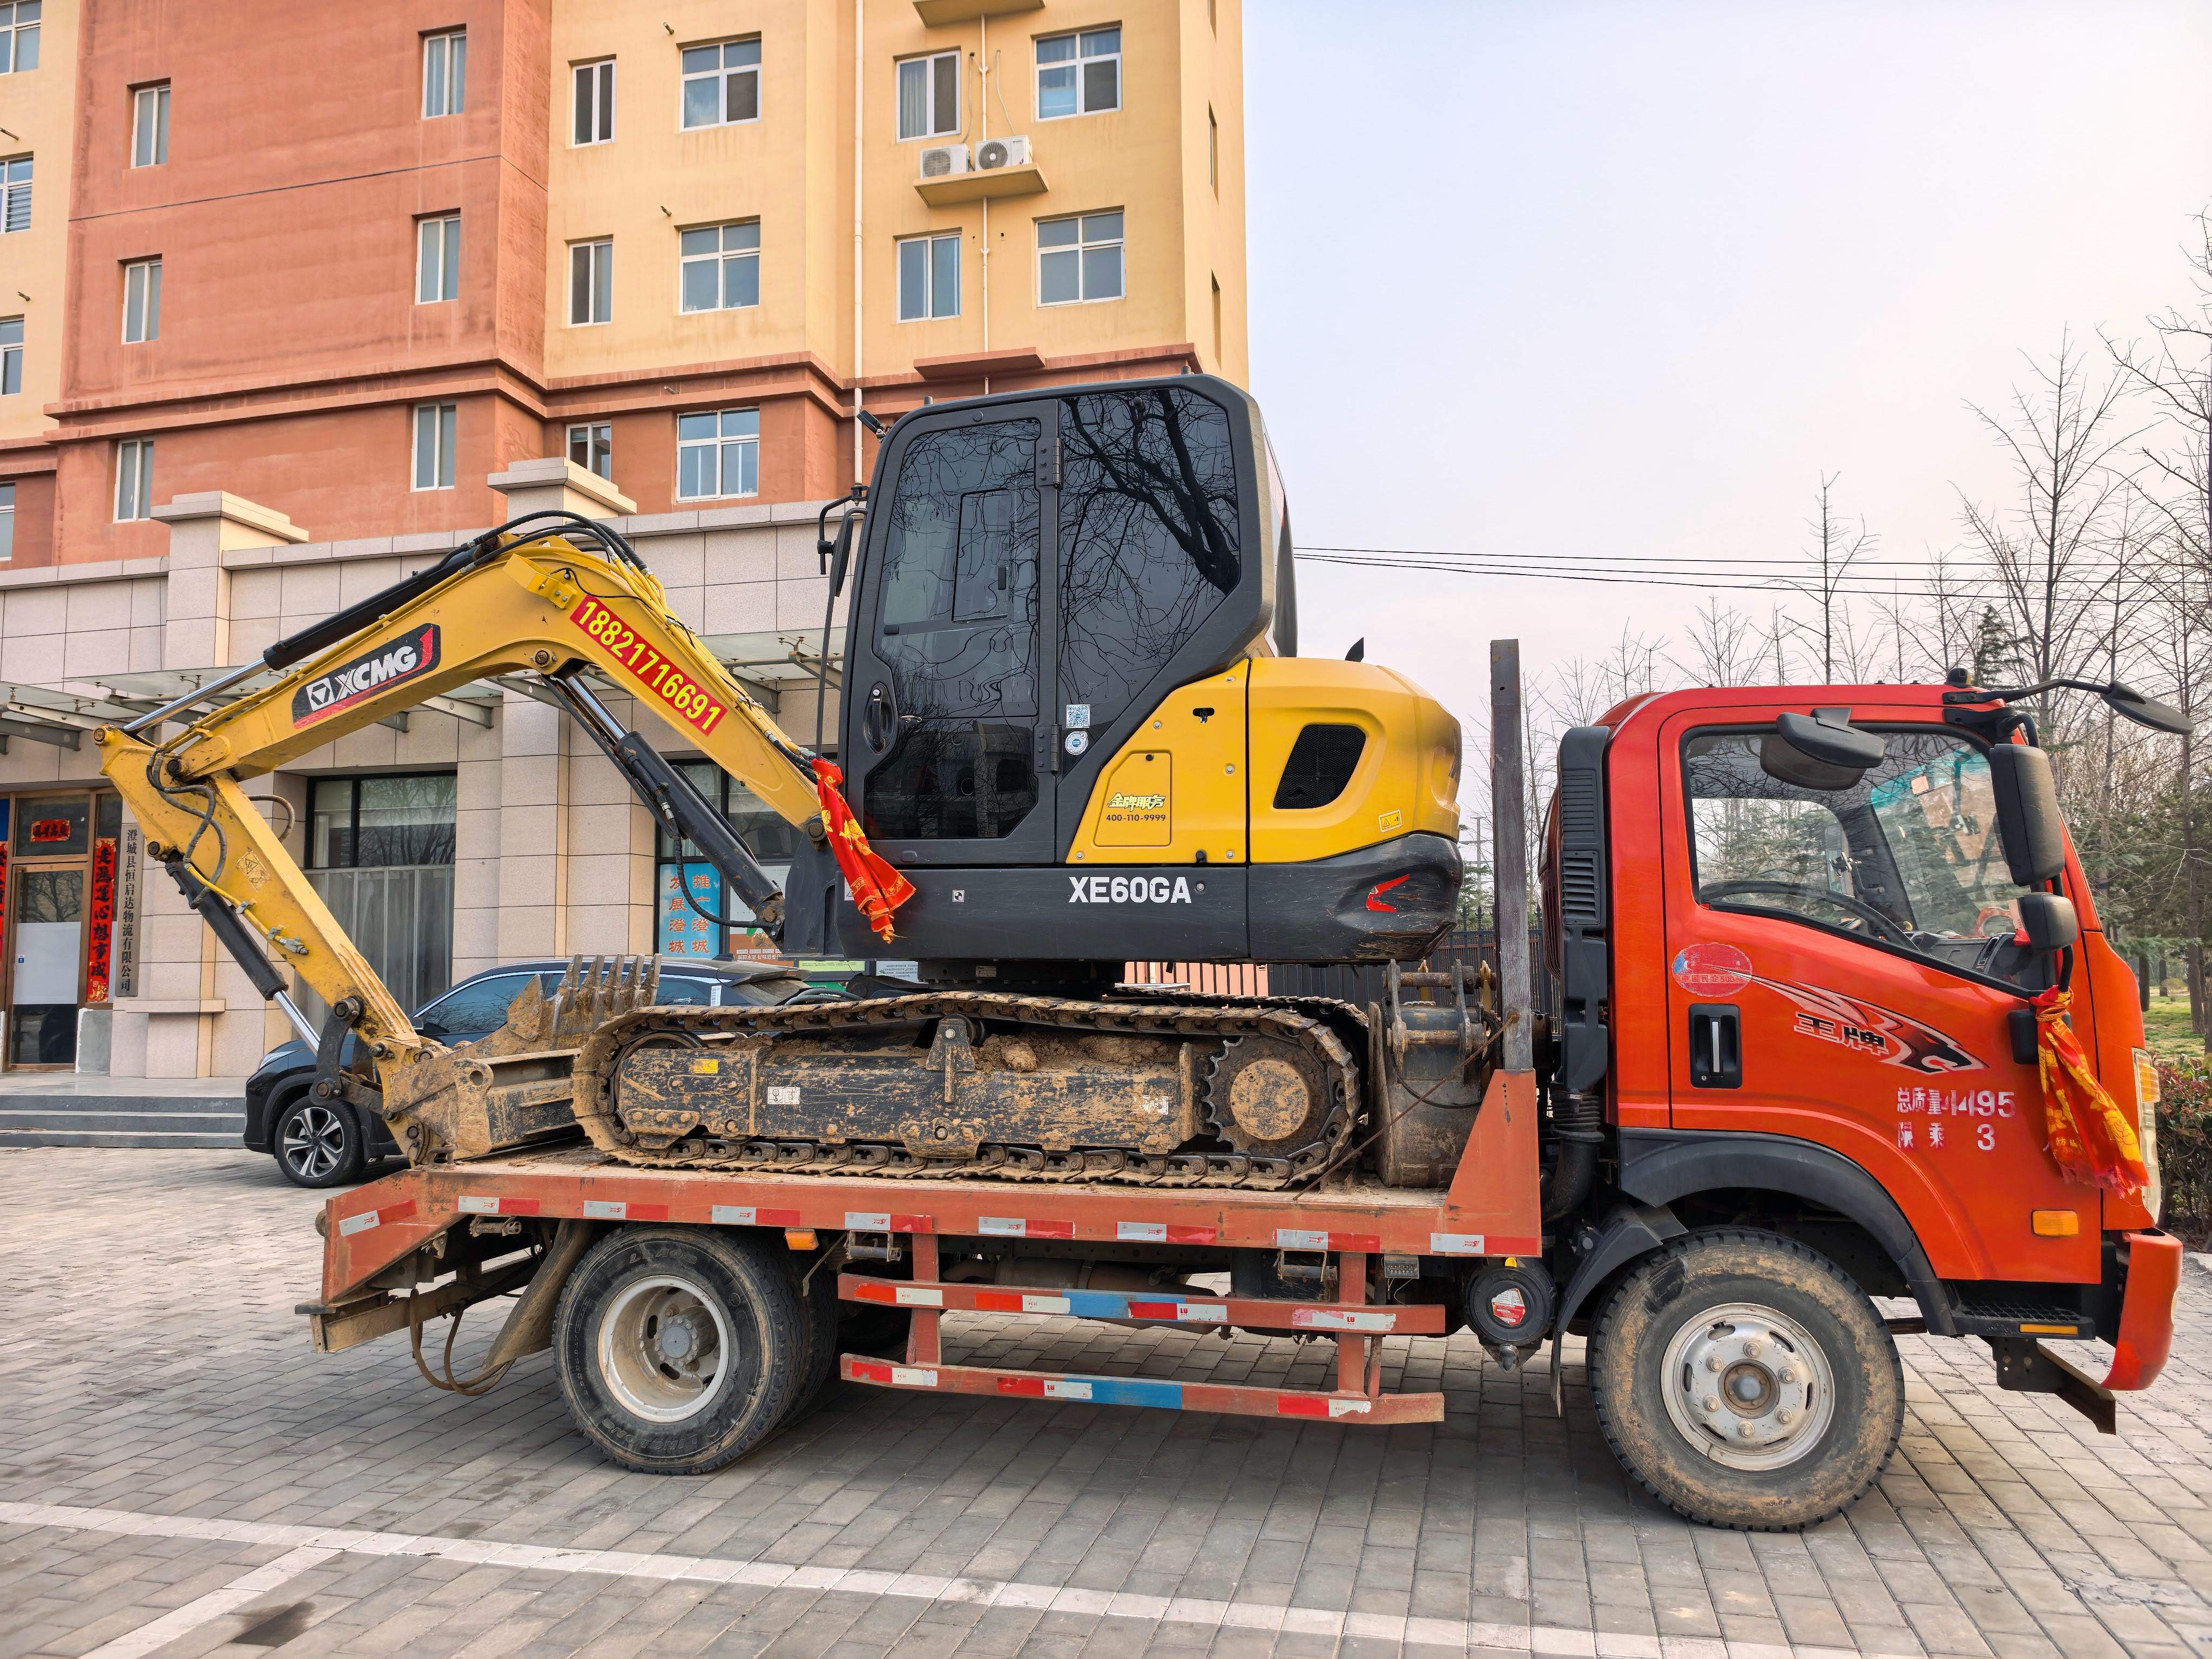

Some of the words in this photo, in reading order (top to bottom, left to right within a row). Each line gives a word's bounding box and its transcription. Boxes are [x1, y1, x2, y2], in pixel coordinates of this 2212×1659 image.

[335, 646, 417, 702] XCMG
[579, 602, 720, 730] 18821716691
[1108, 793, 1166, 812] 金牌服务
[120, 829, 138, 992] 澄城县恒启达物流有限公司
[1068, 876, 1192, 903] XE60GA
[1793, 1011, 1890, 1056] 王牌
[1977, 1123, 1995, 1150] 3
